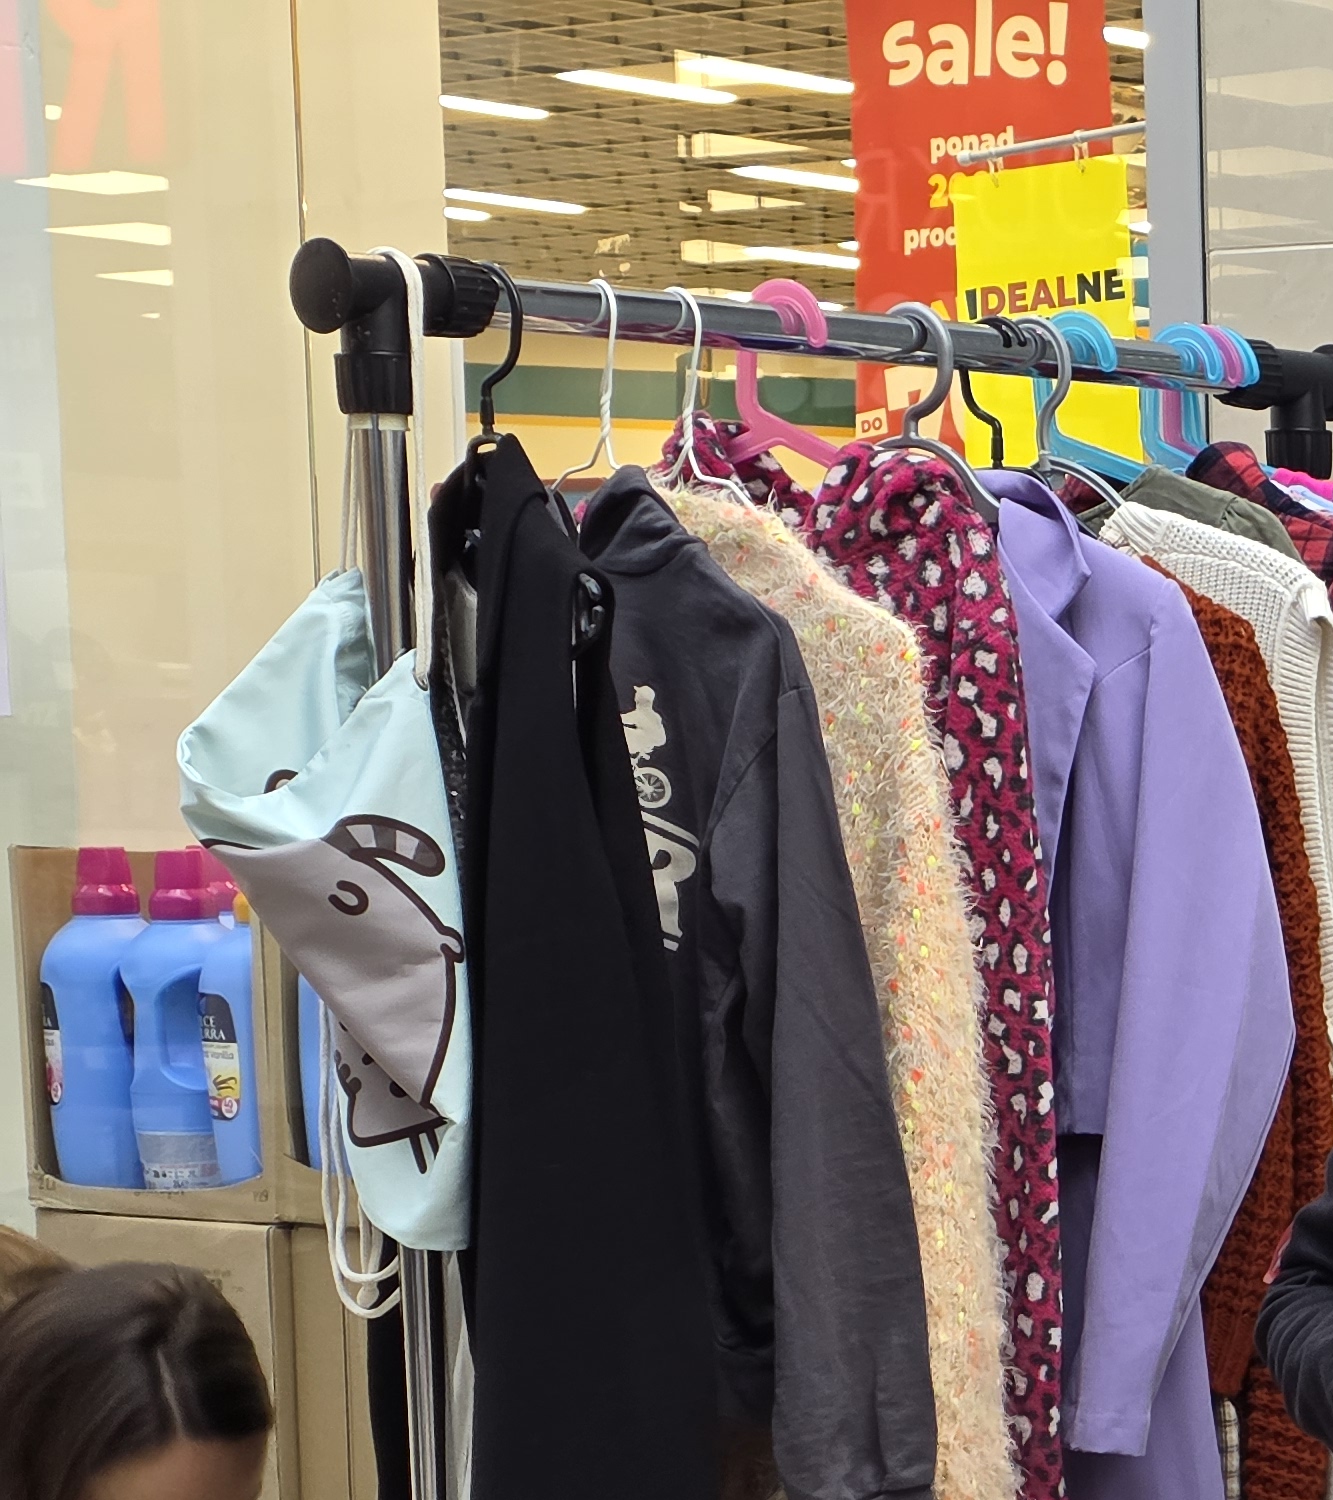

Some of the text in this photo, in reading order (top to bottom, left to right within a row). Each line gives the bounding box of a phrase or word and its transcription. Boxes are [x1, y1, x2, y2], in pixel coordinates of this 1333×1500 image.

[882, 0, 1069, 86] sale!
[930, 125, 1015, 164] ponad
[965, 268, 1125, 320] IDEALNE
[861, 416, 883, 433] DO
